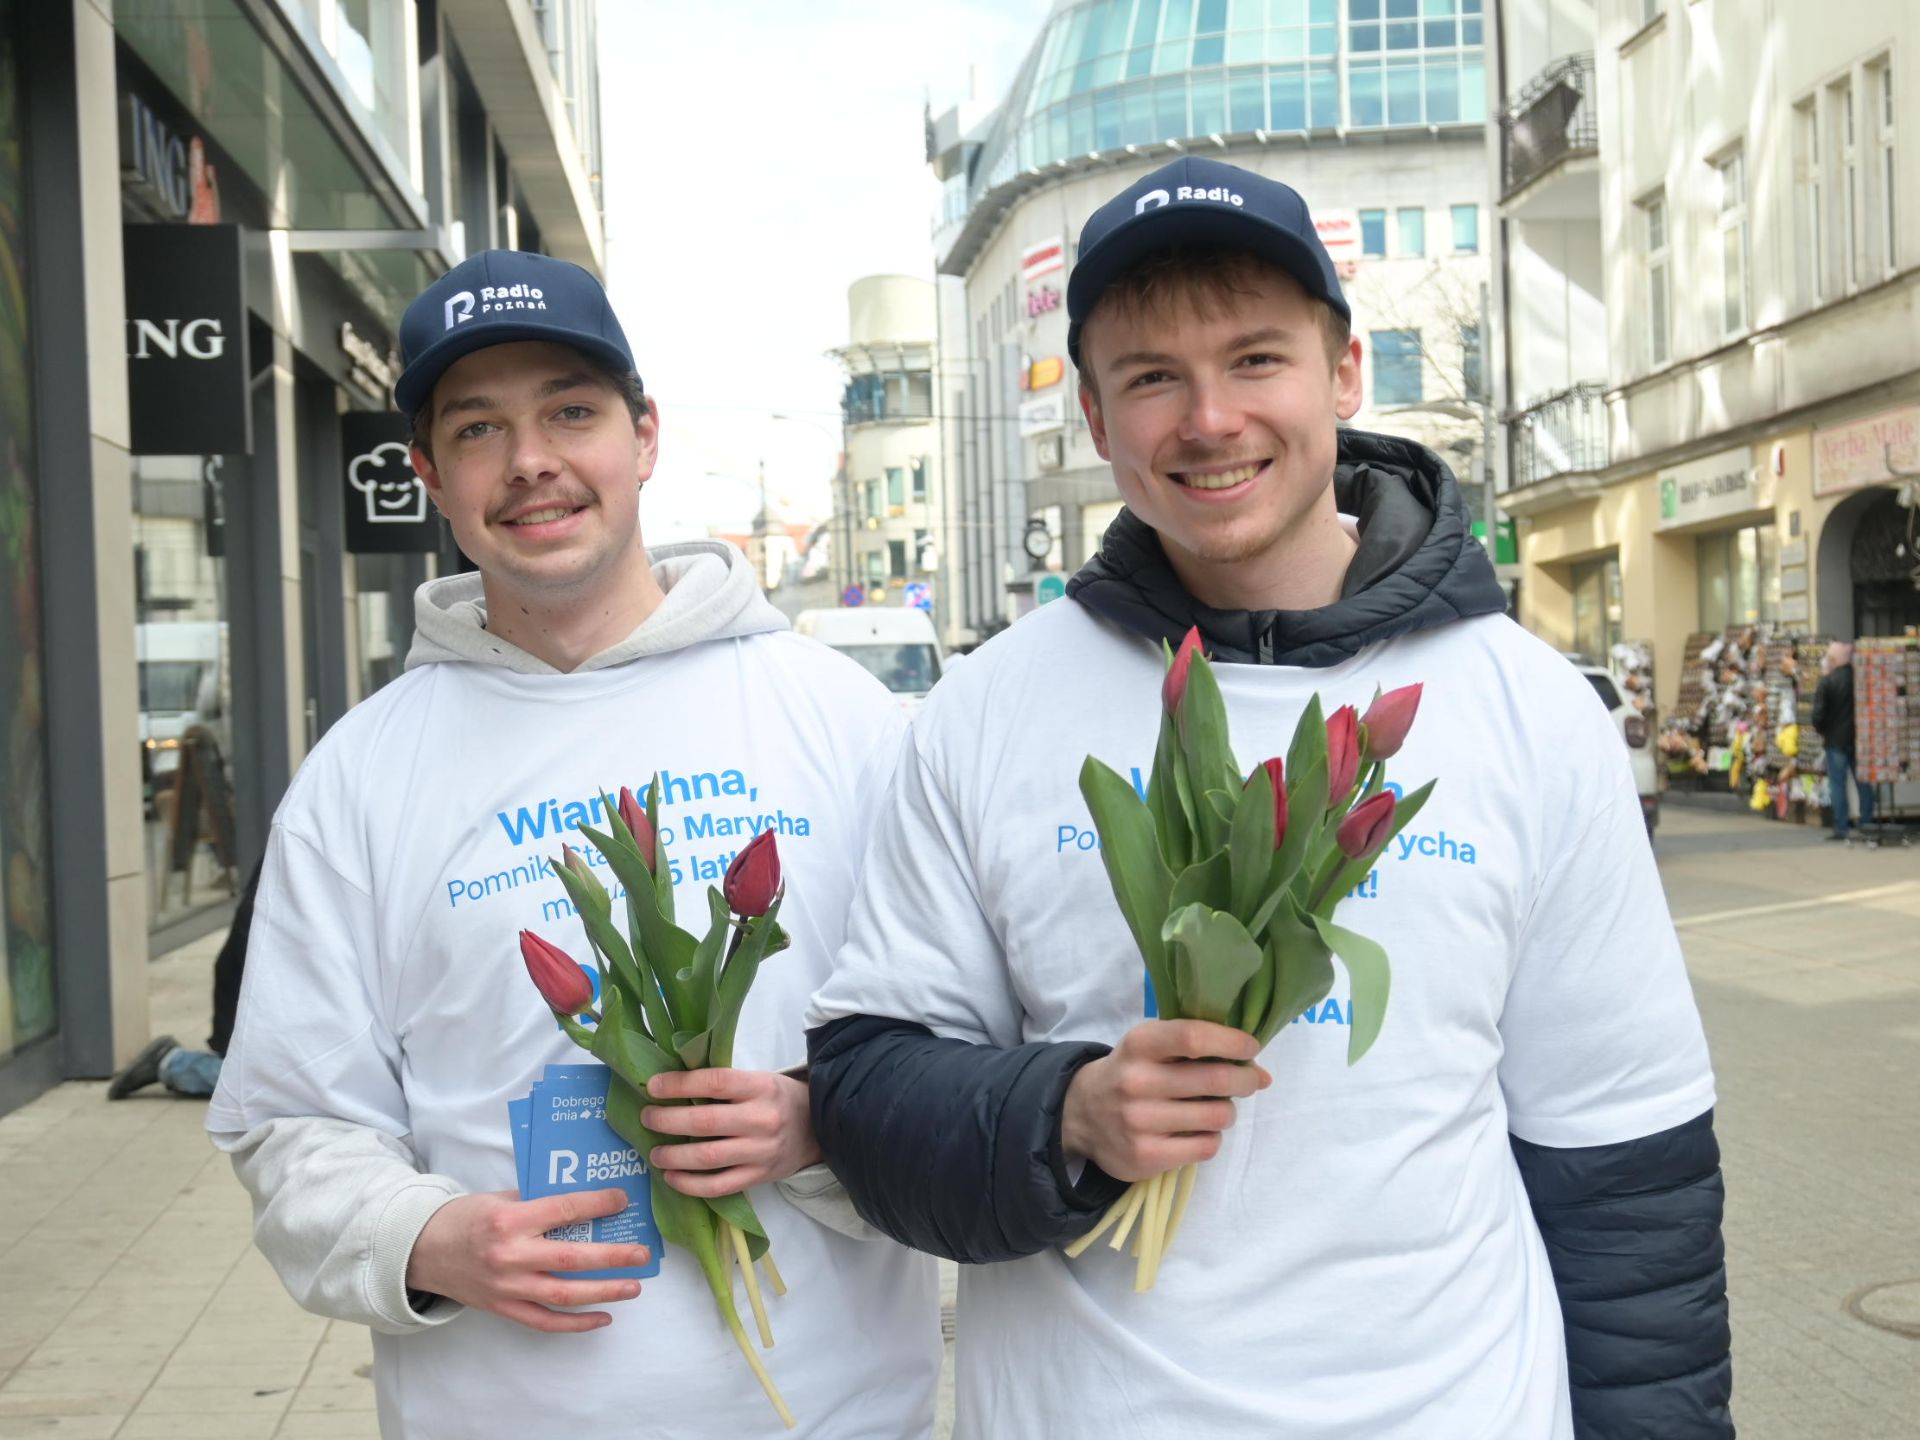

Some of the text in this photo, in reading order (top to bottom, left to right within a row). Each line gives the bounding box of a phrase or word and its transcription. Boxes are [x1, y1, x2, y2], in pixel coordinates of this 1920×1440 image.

[1177, 186, 1244, 206] Radio
[480, 284, 544, 302] Radio
[482, 300, 547, 313] Poznań
[126, 317, 226, 360] NG
[497, 768, 758, 847] Wiarchna,
[1386, 831, 1476, 865] ycha
[448, 855, 557, 907] Pomnik
[684, 810, 810, 841] Marycha
[552, 1096, 604, 1109] Dobrego
[552, 1110, 578, 1122] dnia
[587, 1149, 640, 1167] RADIO
